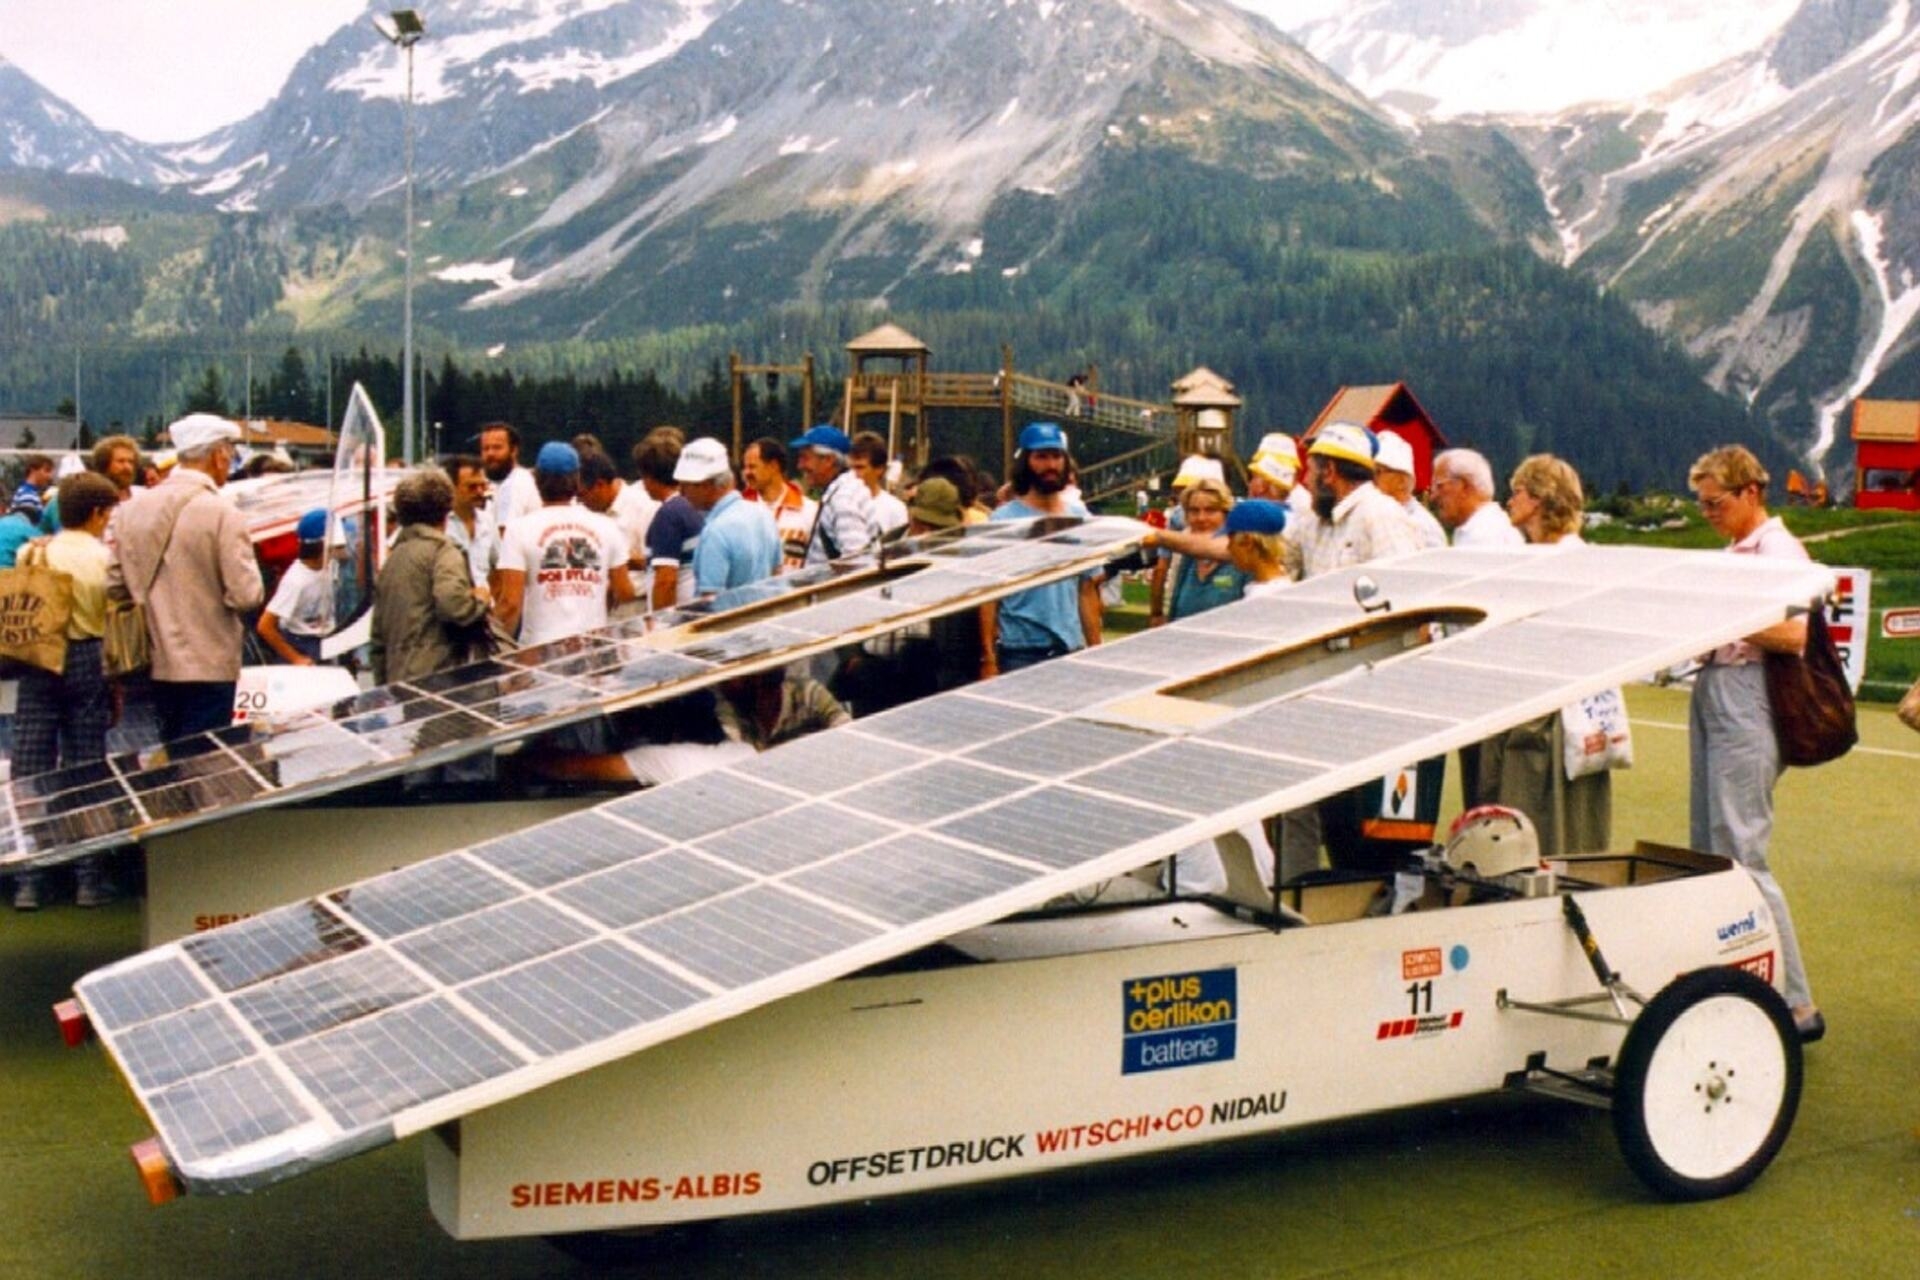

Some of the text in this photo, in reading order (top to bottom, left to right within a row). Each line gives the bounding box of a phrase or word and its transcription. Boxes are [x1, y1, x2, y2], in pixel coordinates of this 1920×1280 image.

[237, 691, 267, 709] 20
[1406, 979, 1432, 1015] 11
[1129, 999, 1231, 1032] oerlikon
[1141, 1035, 1218, 1066] batterie
[807, 1091, 1287, 1186] OFFSETDRUCK WITSCHI+CO NIDAU
[510, 1172, 762, 1208] SIEMENS-ALBIS
